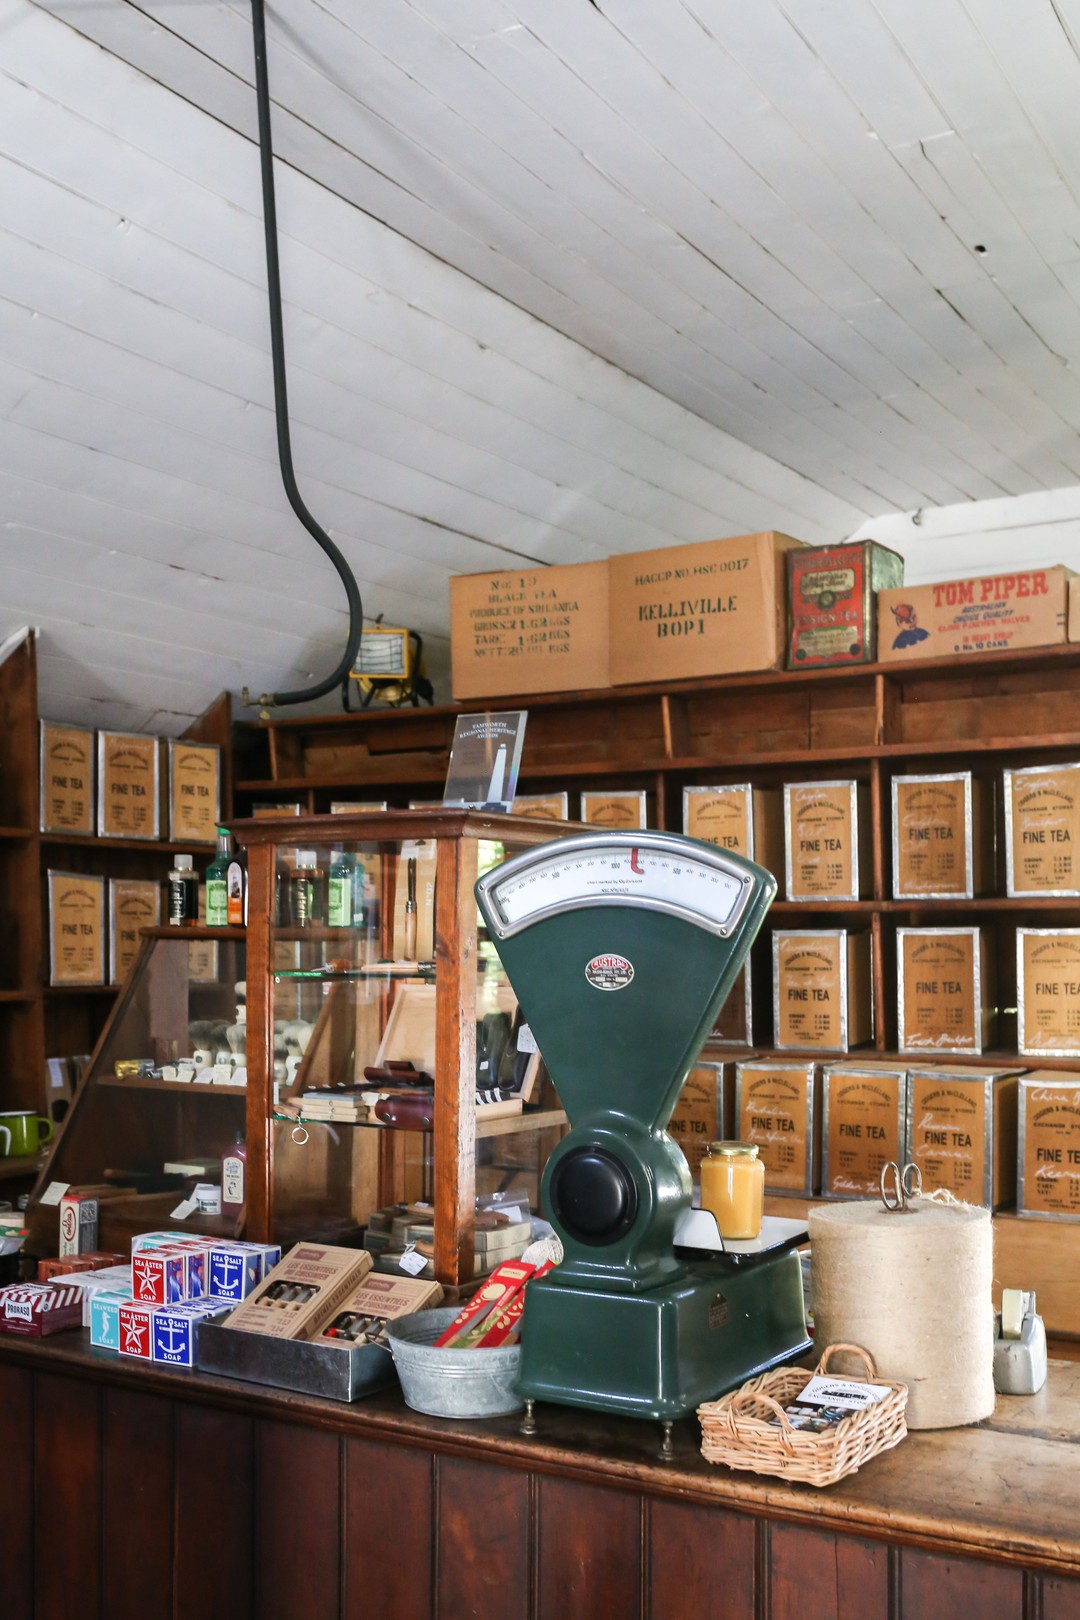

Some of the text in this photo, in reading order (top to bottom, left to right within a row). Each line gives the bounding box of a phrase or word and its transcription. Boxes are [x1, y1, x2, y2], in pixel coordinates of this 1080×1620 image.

[932, 571, 1049, 609] TOM PIPER
[638, 595, 739, 622] KELLIVILLE
[52, 776, 84, 790] FINE TEA
[111, 783, 146, 796] FINE TEA
[181, 784, 210, 798] FINE TEA
[909, 826, 954, 841] FINE TEA
[1023, 829, 1071, 844] FINE TEA
[723, 837, 740, 848] TEA
[800, 839, 842, 852] FINE TEA
[62, 923, 94, 936] FINE TEA
[121, 929, 136, 942] FINE
[915, 982, 963, 994] FINE TEA
[1035, 983, 1059, 995] FINE
[788, 989, 830, 1001] FINE TEA
[691, 1121, 708, 1134] TEA
[751, 1117, 795, 1132] FINE TEA
[840, 1123, 886, 1139] FINE TEA
[924, 1131, 972, 1147] FINE TEA
[1036, 1147, 1080, 1164] FINE TE
[134, 1259, 145, 1267] SEA
[212, 1255, 243, 1266] SEA SALT
[140, 1293, 156, 1301] SOAP
[217, 1288, 235, 1297] SOAP
[7, 1303, 30, 1316] PRORASO
[93, 1303, 118, 1314] SEAWEED
[155, 1318, 188, 1329] SEA SALT
[99, 1336, 115, 1345] SOAP
[126, 1346, 142, 1355] SOAP
[163, 1353, 182, 1362] SOAP
